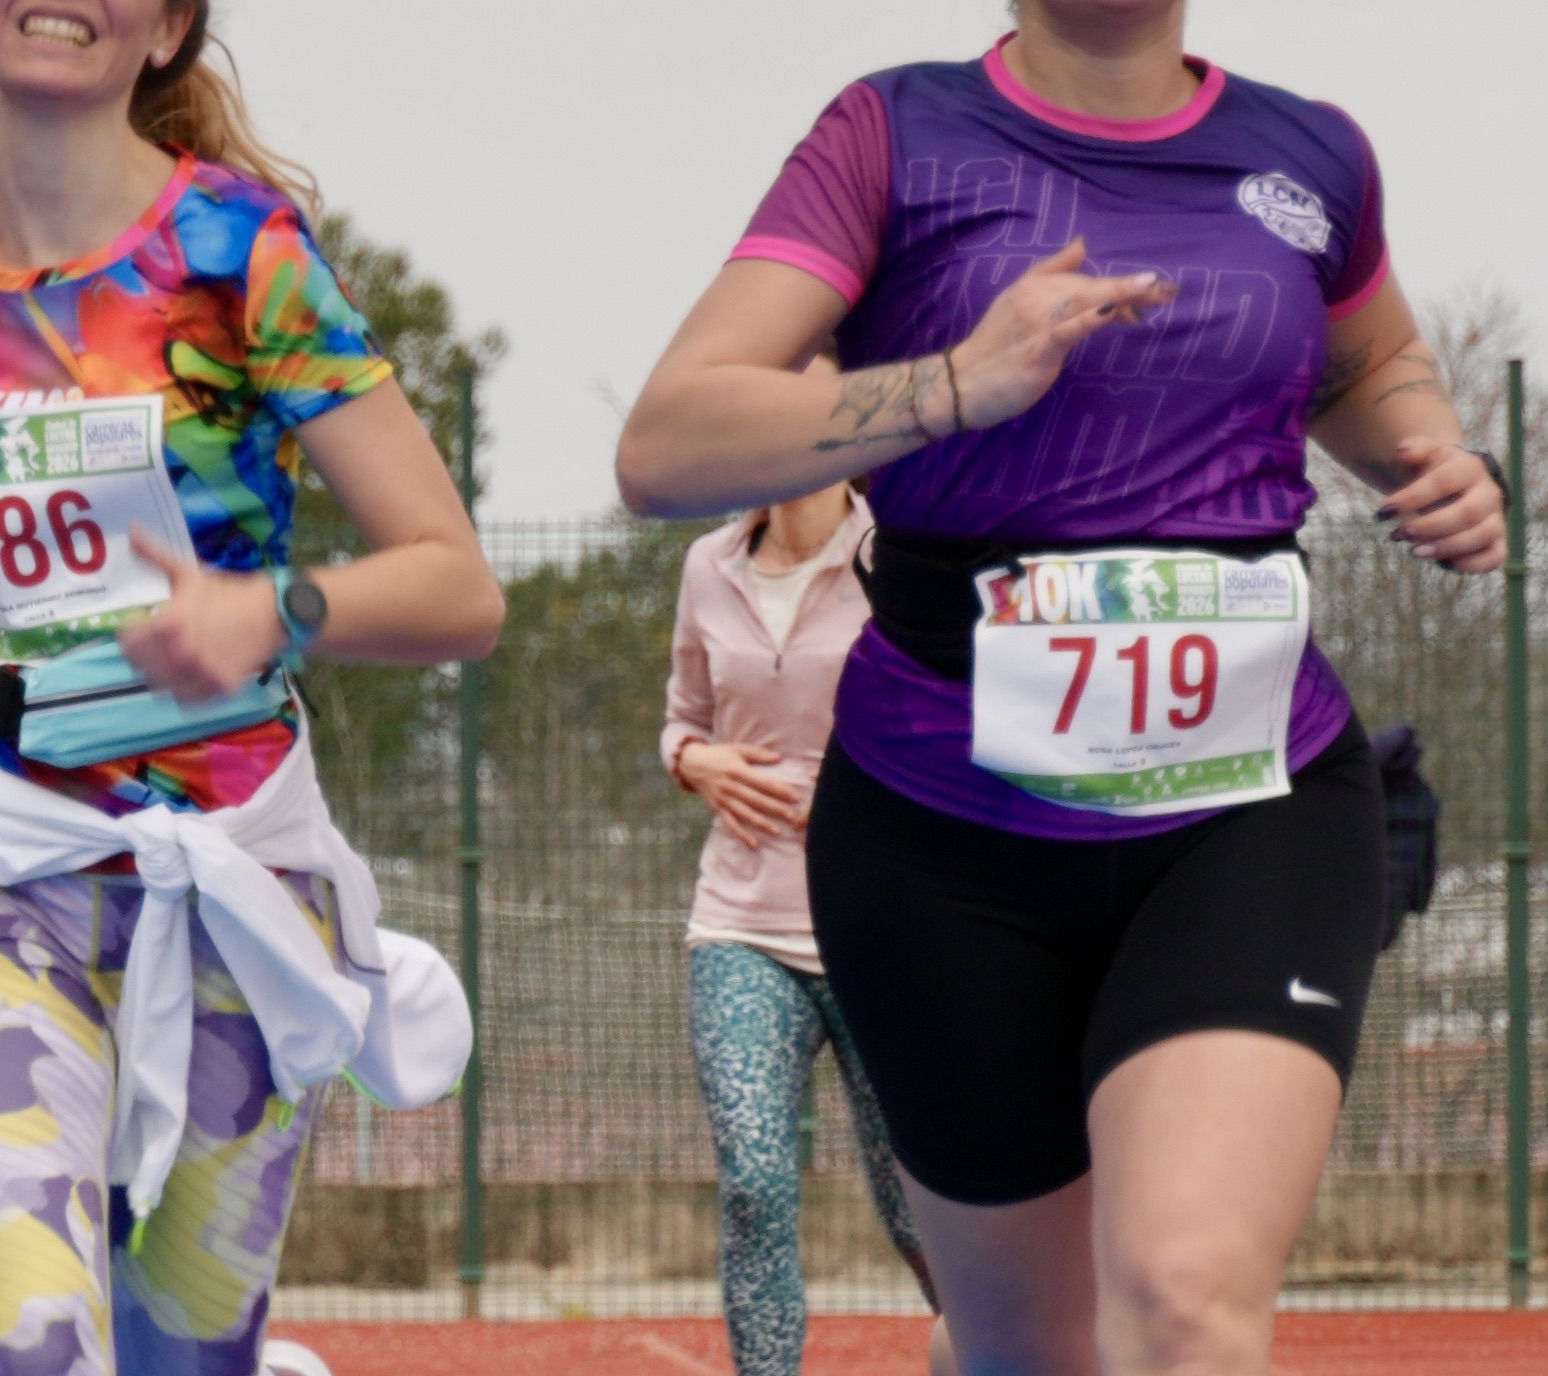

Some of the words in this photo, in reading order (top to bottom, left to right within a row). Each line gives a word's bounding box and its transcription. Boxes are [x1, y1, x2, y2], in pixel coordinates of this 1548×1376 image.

[1011, 562, 1103, 623] 10K
[1177, 596, 1216, 618] 2026
[1047, 633, 1220, 736] 719
